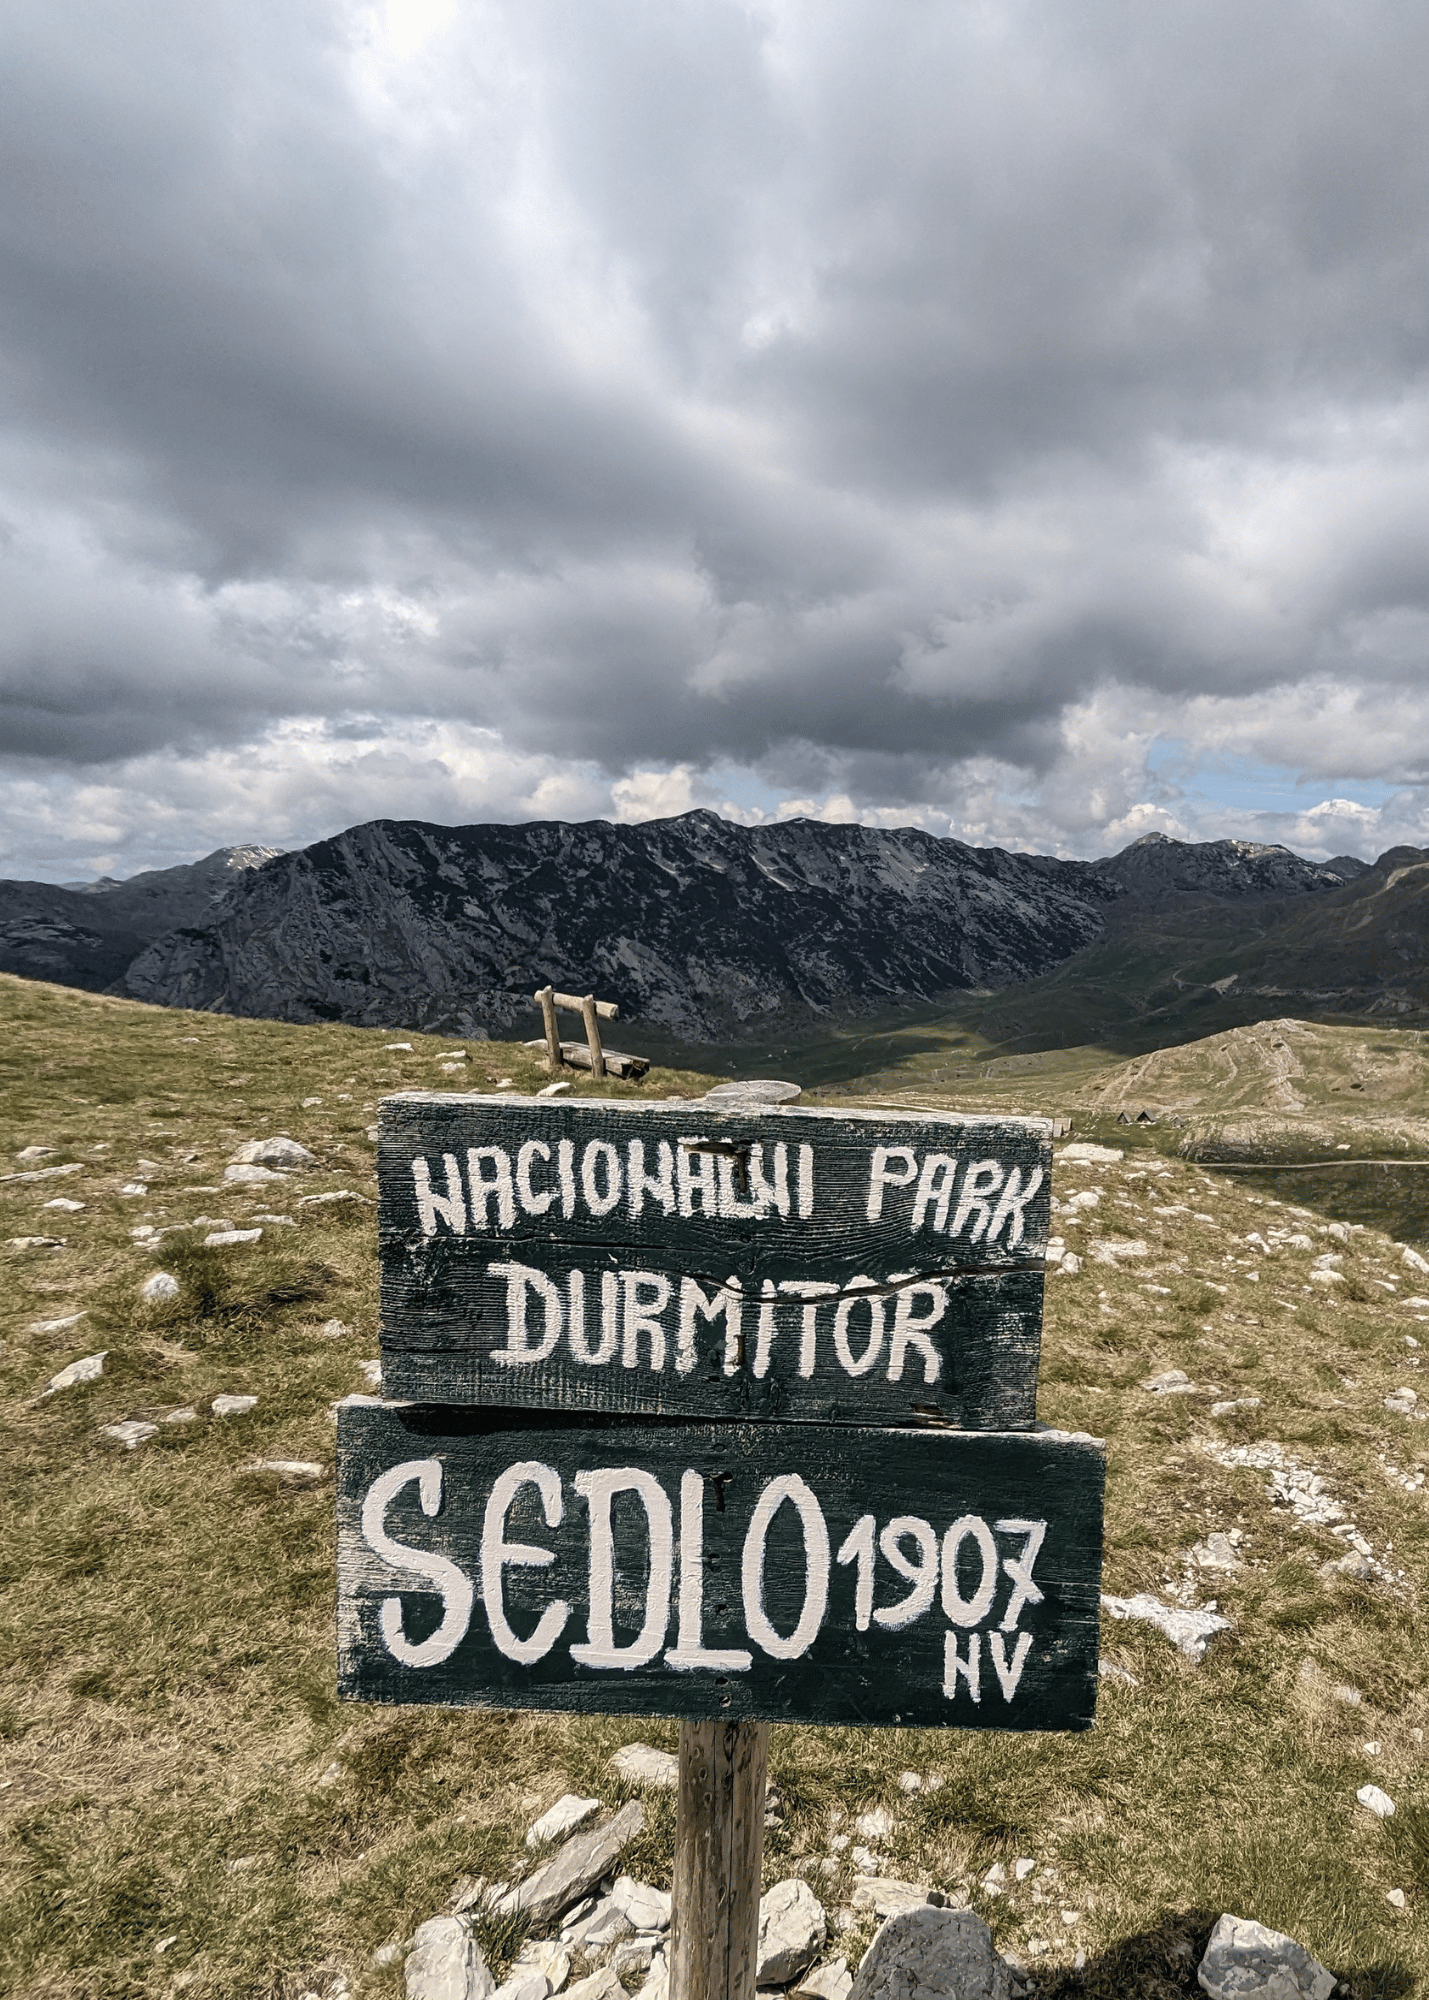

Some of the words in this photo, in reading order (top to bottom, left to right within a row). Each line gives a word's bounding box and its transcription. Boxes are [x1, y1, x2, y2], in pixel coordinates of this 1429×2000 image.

[411, 1136, 815, 1236] NACIONALNI
[865, 1146, 1045, 1251] PARK
[488, 1261, 948, 1384] DURMITOR
[361, 1458, 829, 1670] SEDLO
[837, 1514, 1048, 1632] 1907
[944, 1630, 1033, 1702] NV
